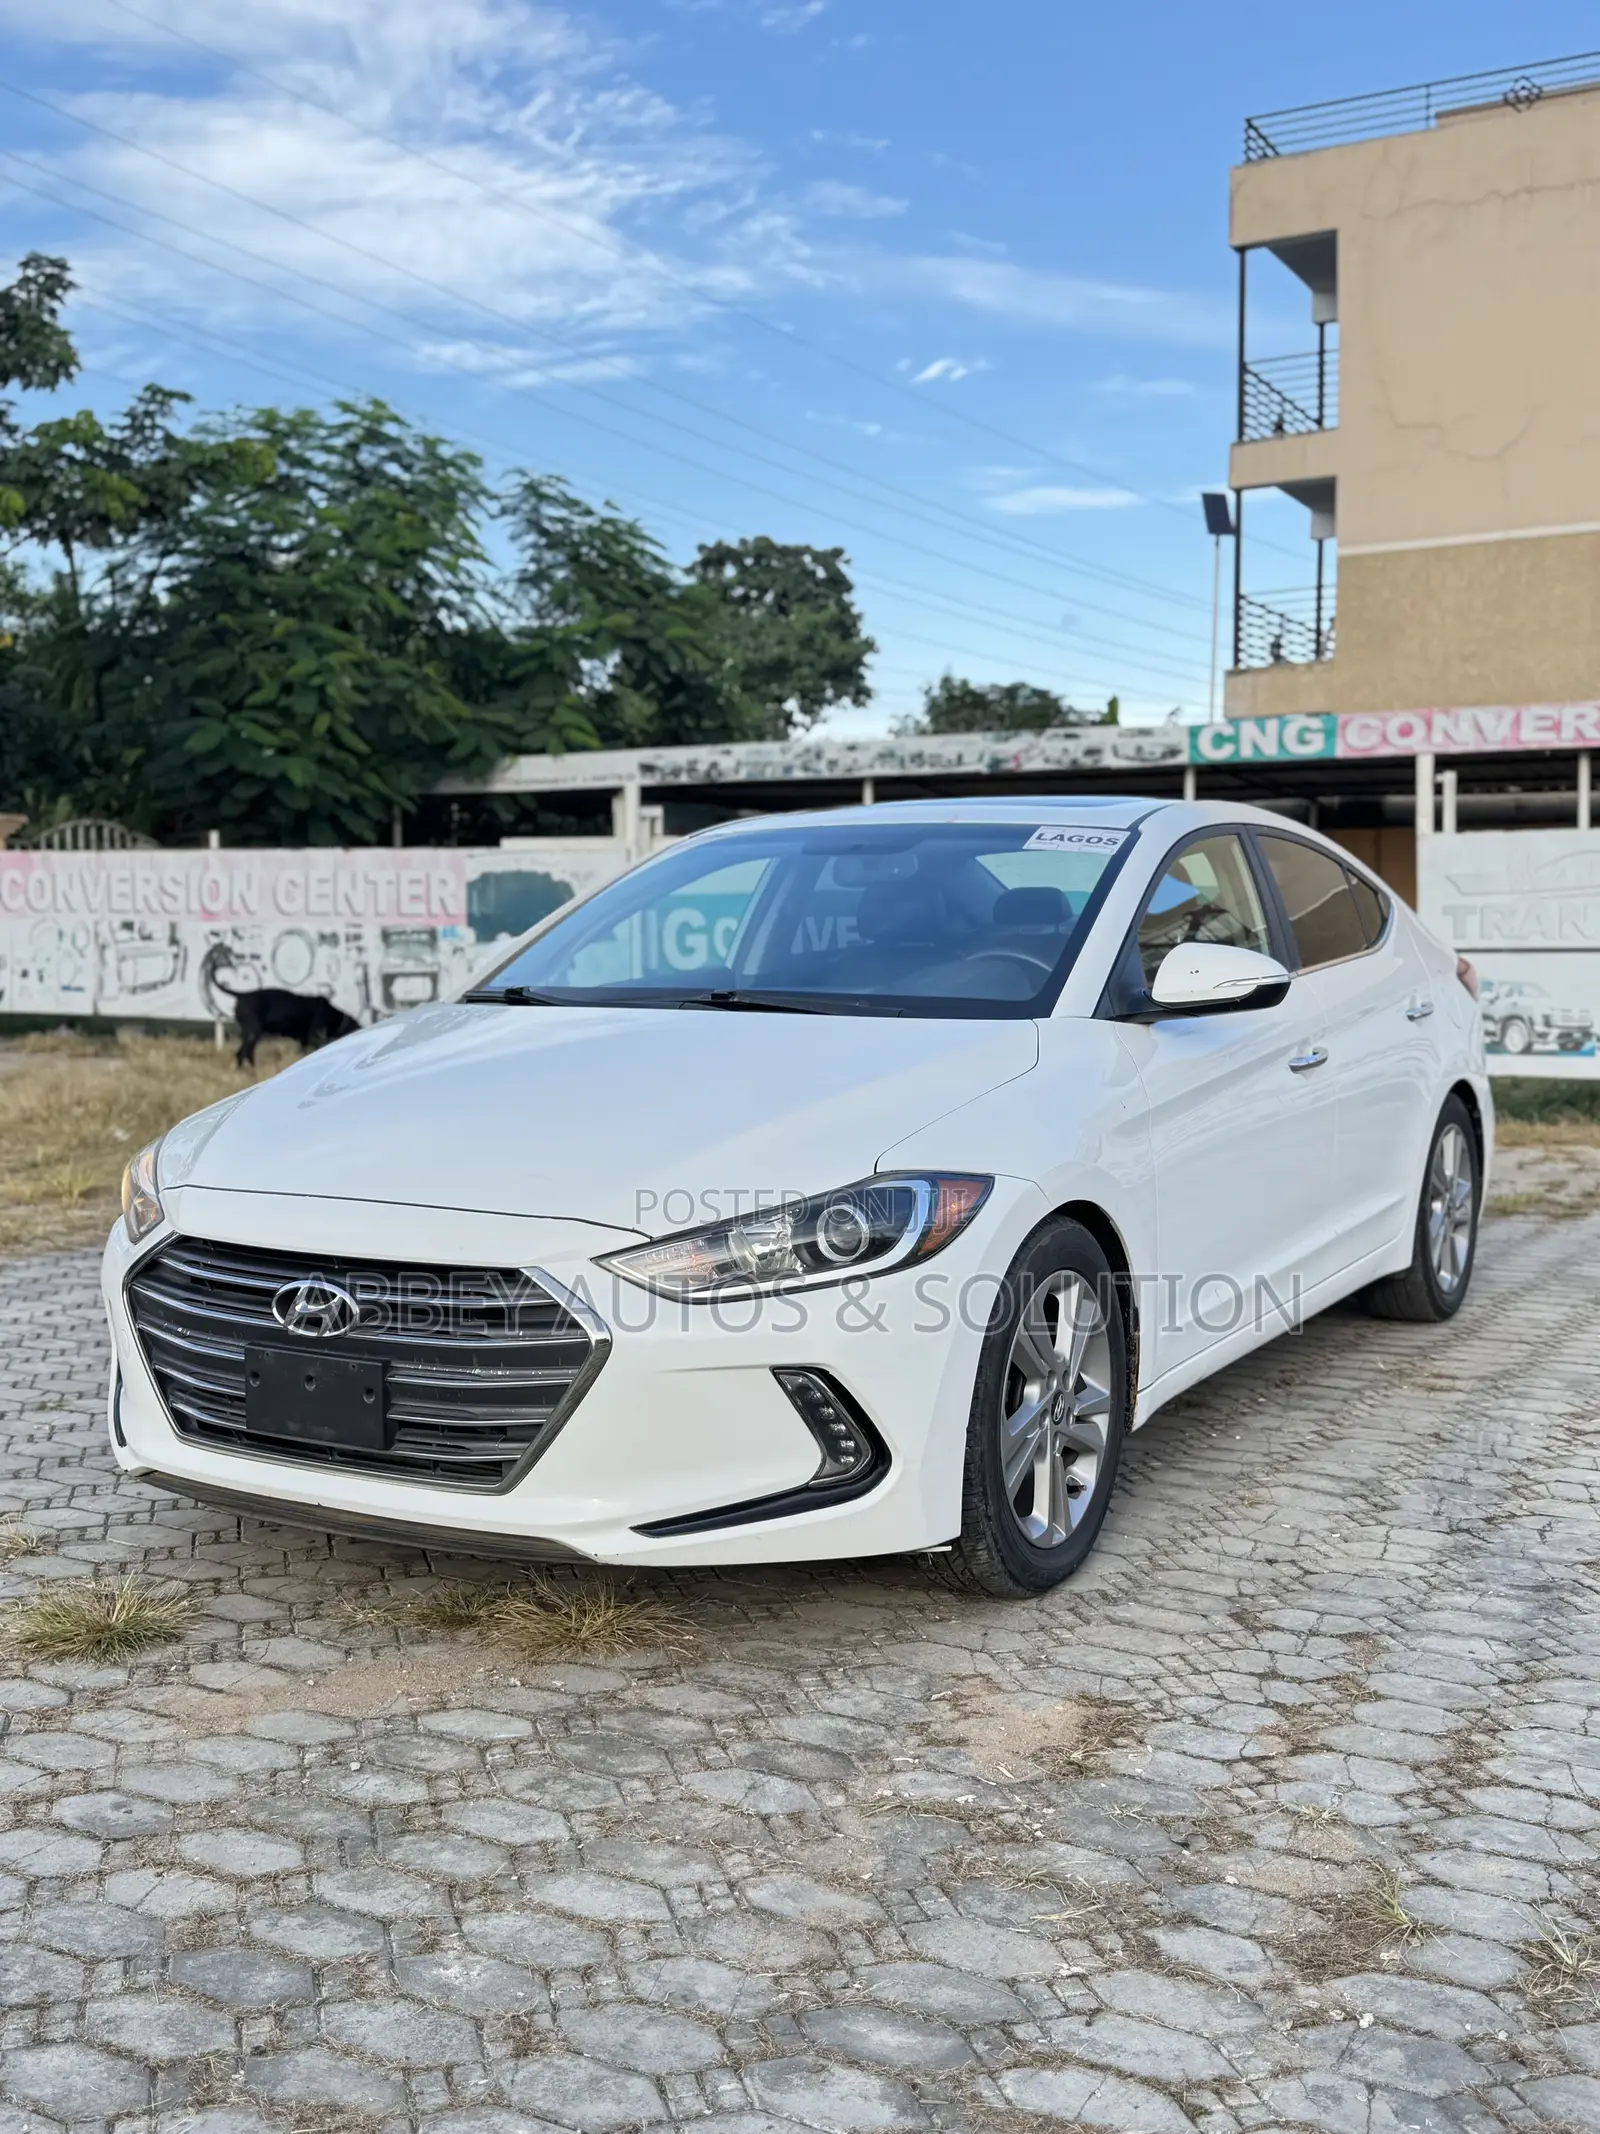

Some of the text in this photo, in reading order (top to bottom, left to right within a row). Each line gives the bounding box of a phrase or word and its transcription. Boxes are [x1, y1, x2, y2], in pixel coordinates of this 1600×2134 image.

[1197, 705, 1600, 760] CNG CONVER
[1035, 832, 1119, 846] LAGOS
[0, 869, 460, 917] CONVERSION CENTER
